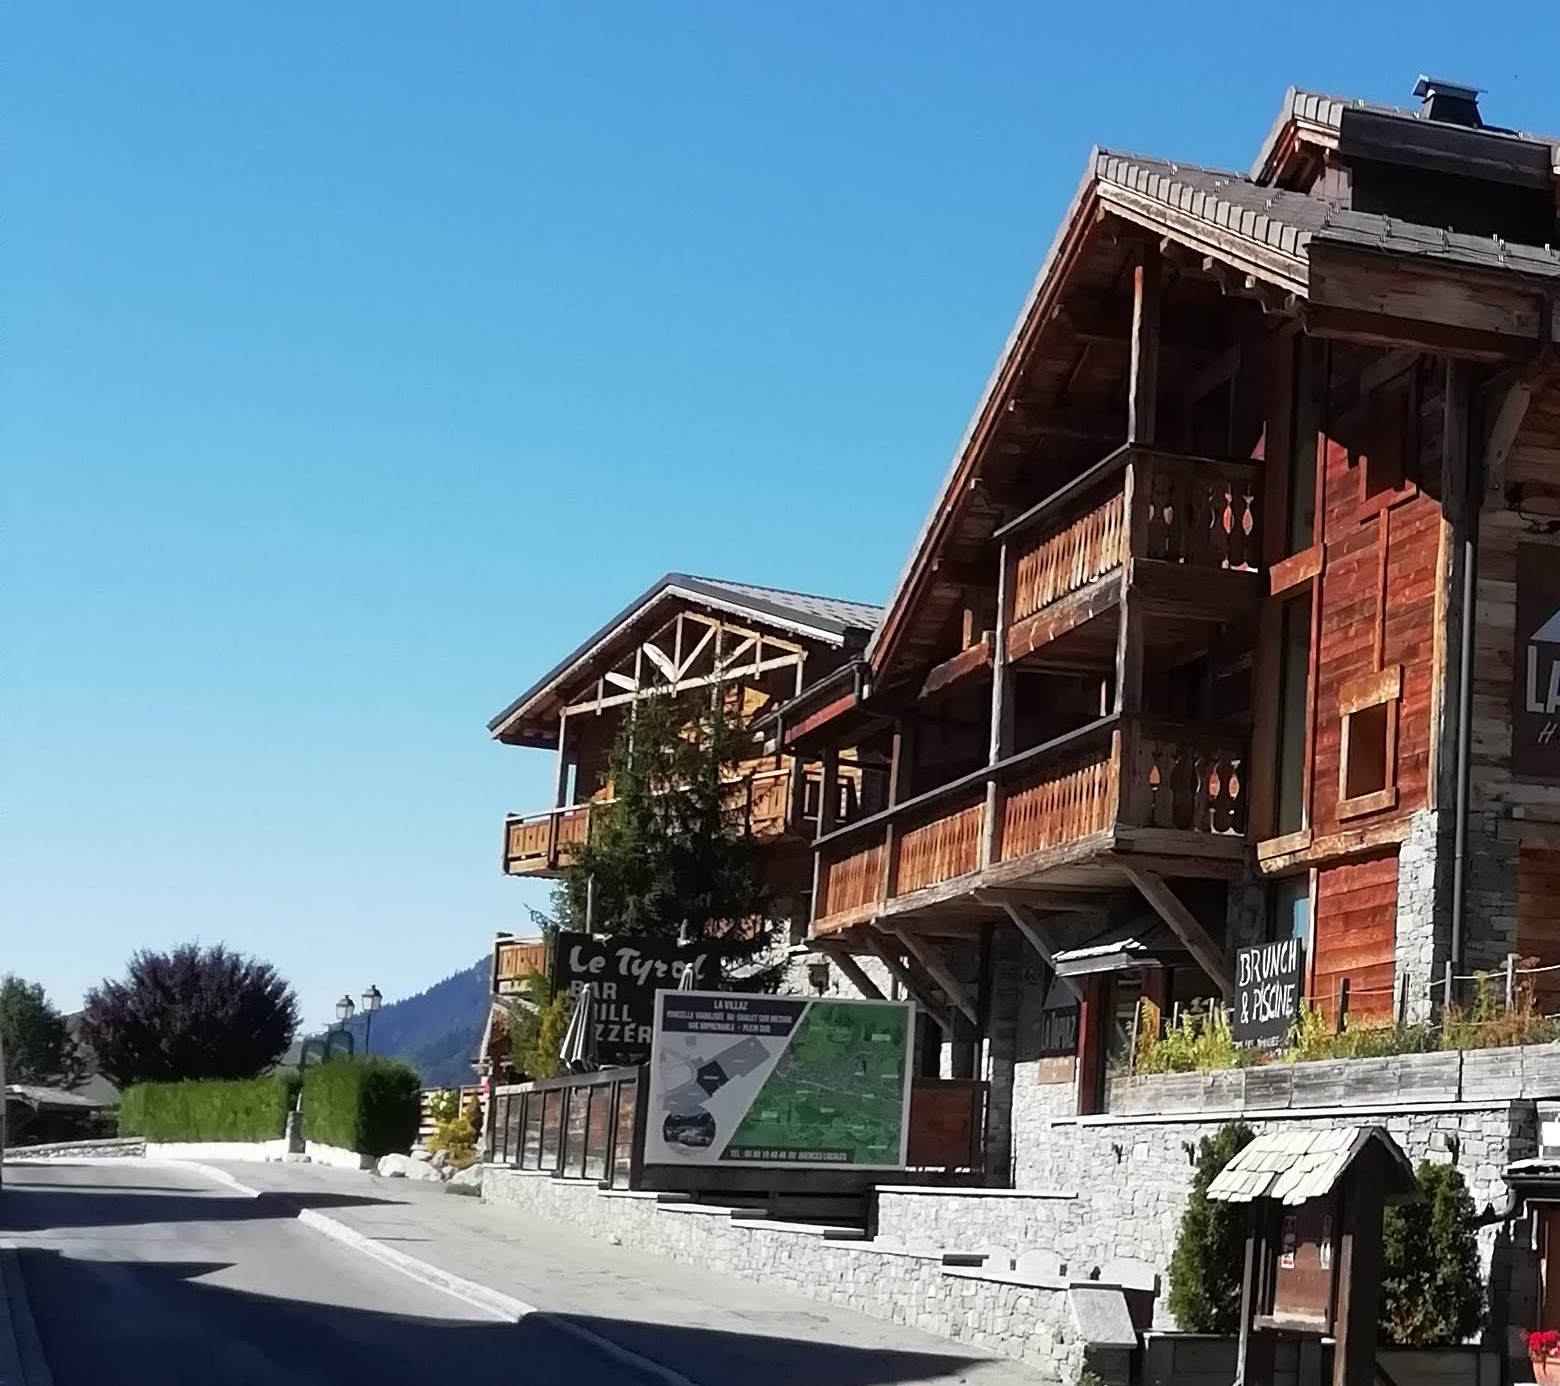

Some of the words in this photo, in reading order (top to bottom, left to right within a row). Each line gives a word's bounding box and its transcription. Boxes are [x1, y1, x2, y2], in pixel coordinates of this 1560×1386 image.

[569, 945, 606, 974] Le
[615, 947, 708, 986] Tyrol
[1239, 939, 1297, 987] BRUNCH
[590, 1002, 632, 1022] ILL
[1240, 992, 1249, 1024] &
[1252, 980, 1295, 1023] PISCINE
